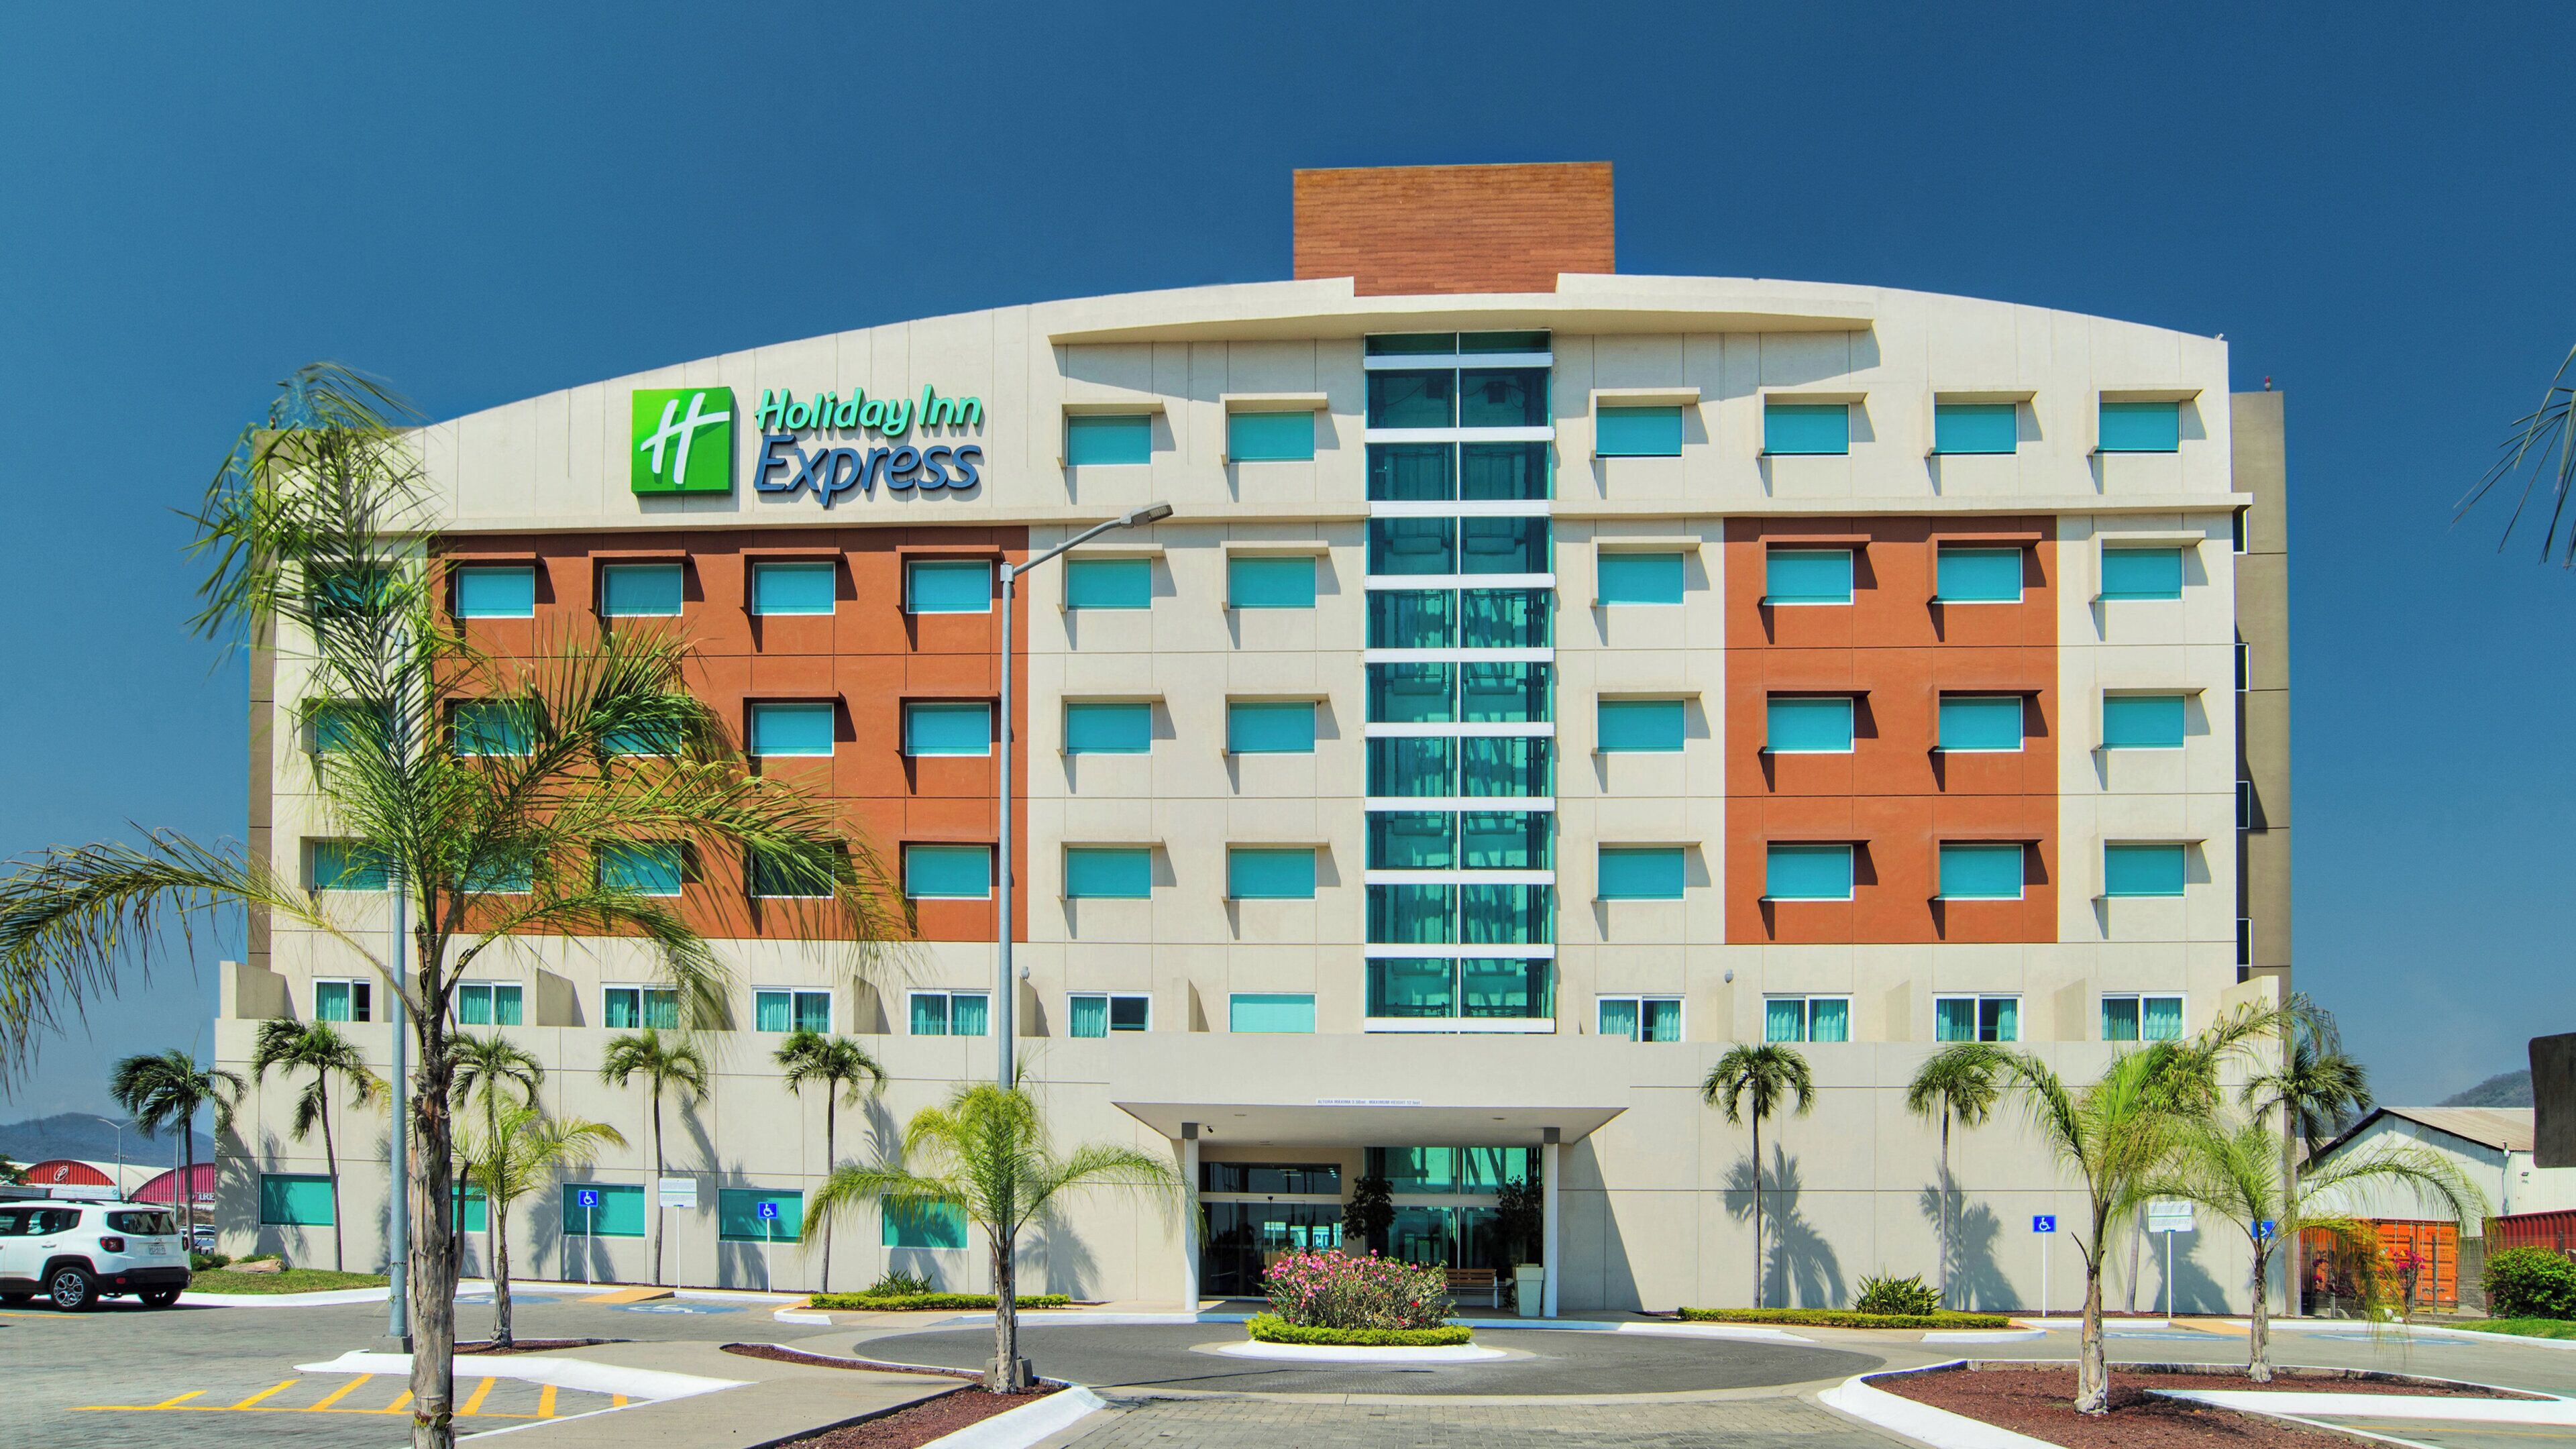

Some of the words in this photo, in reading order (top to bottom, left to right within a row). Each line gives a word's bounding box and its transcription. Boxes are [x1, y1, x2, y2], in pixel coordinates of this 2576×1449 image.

[755, 387, 912, 437] Holiday
[918, 384, 982, 427] Inn
[753, 434, 981, 508] Express
